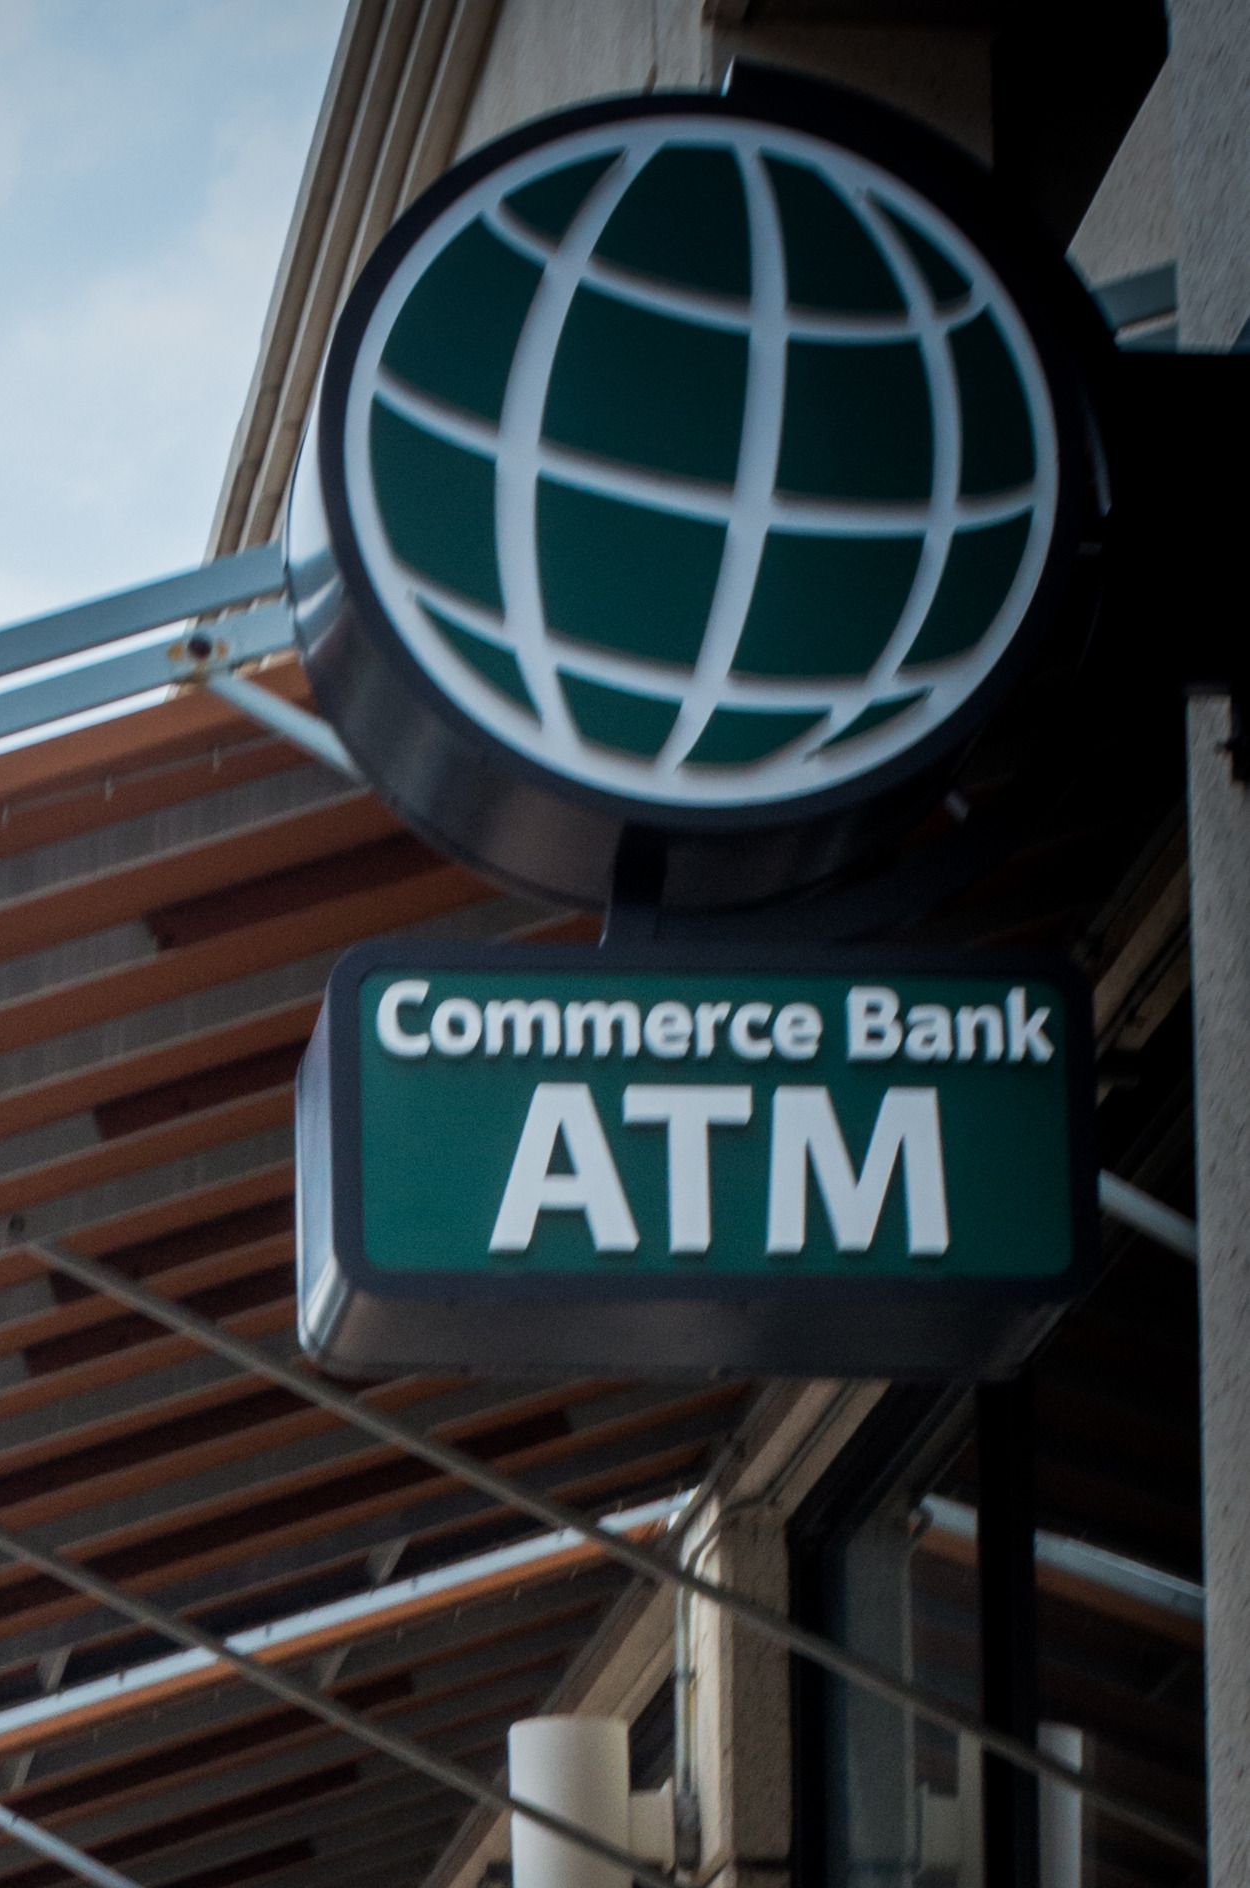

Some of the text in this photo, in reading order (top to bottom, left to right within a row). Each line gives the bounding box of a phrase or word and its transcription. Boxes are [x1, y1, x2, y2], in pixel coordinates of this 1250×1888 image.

[376, 979, 1055, 1062] Commerce Bank
[487, 1081, 951, 1256] ATM
